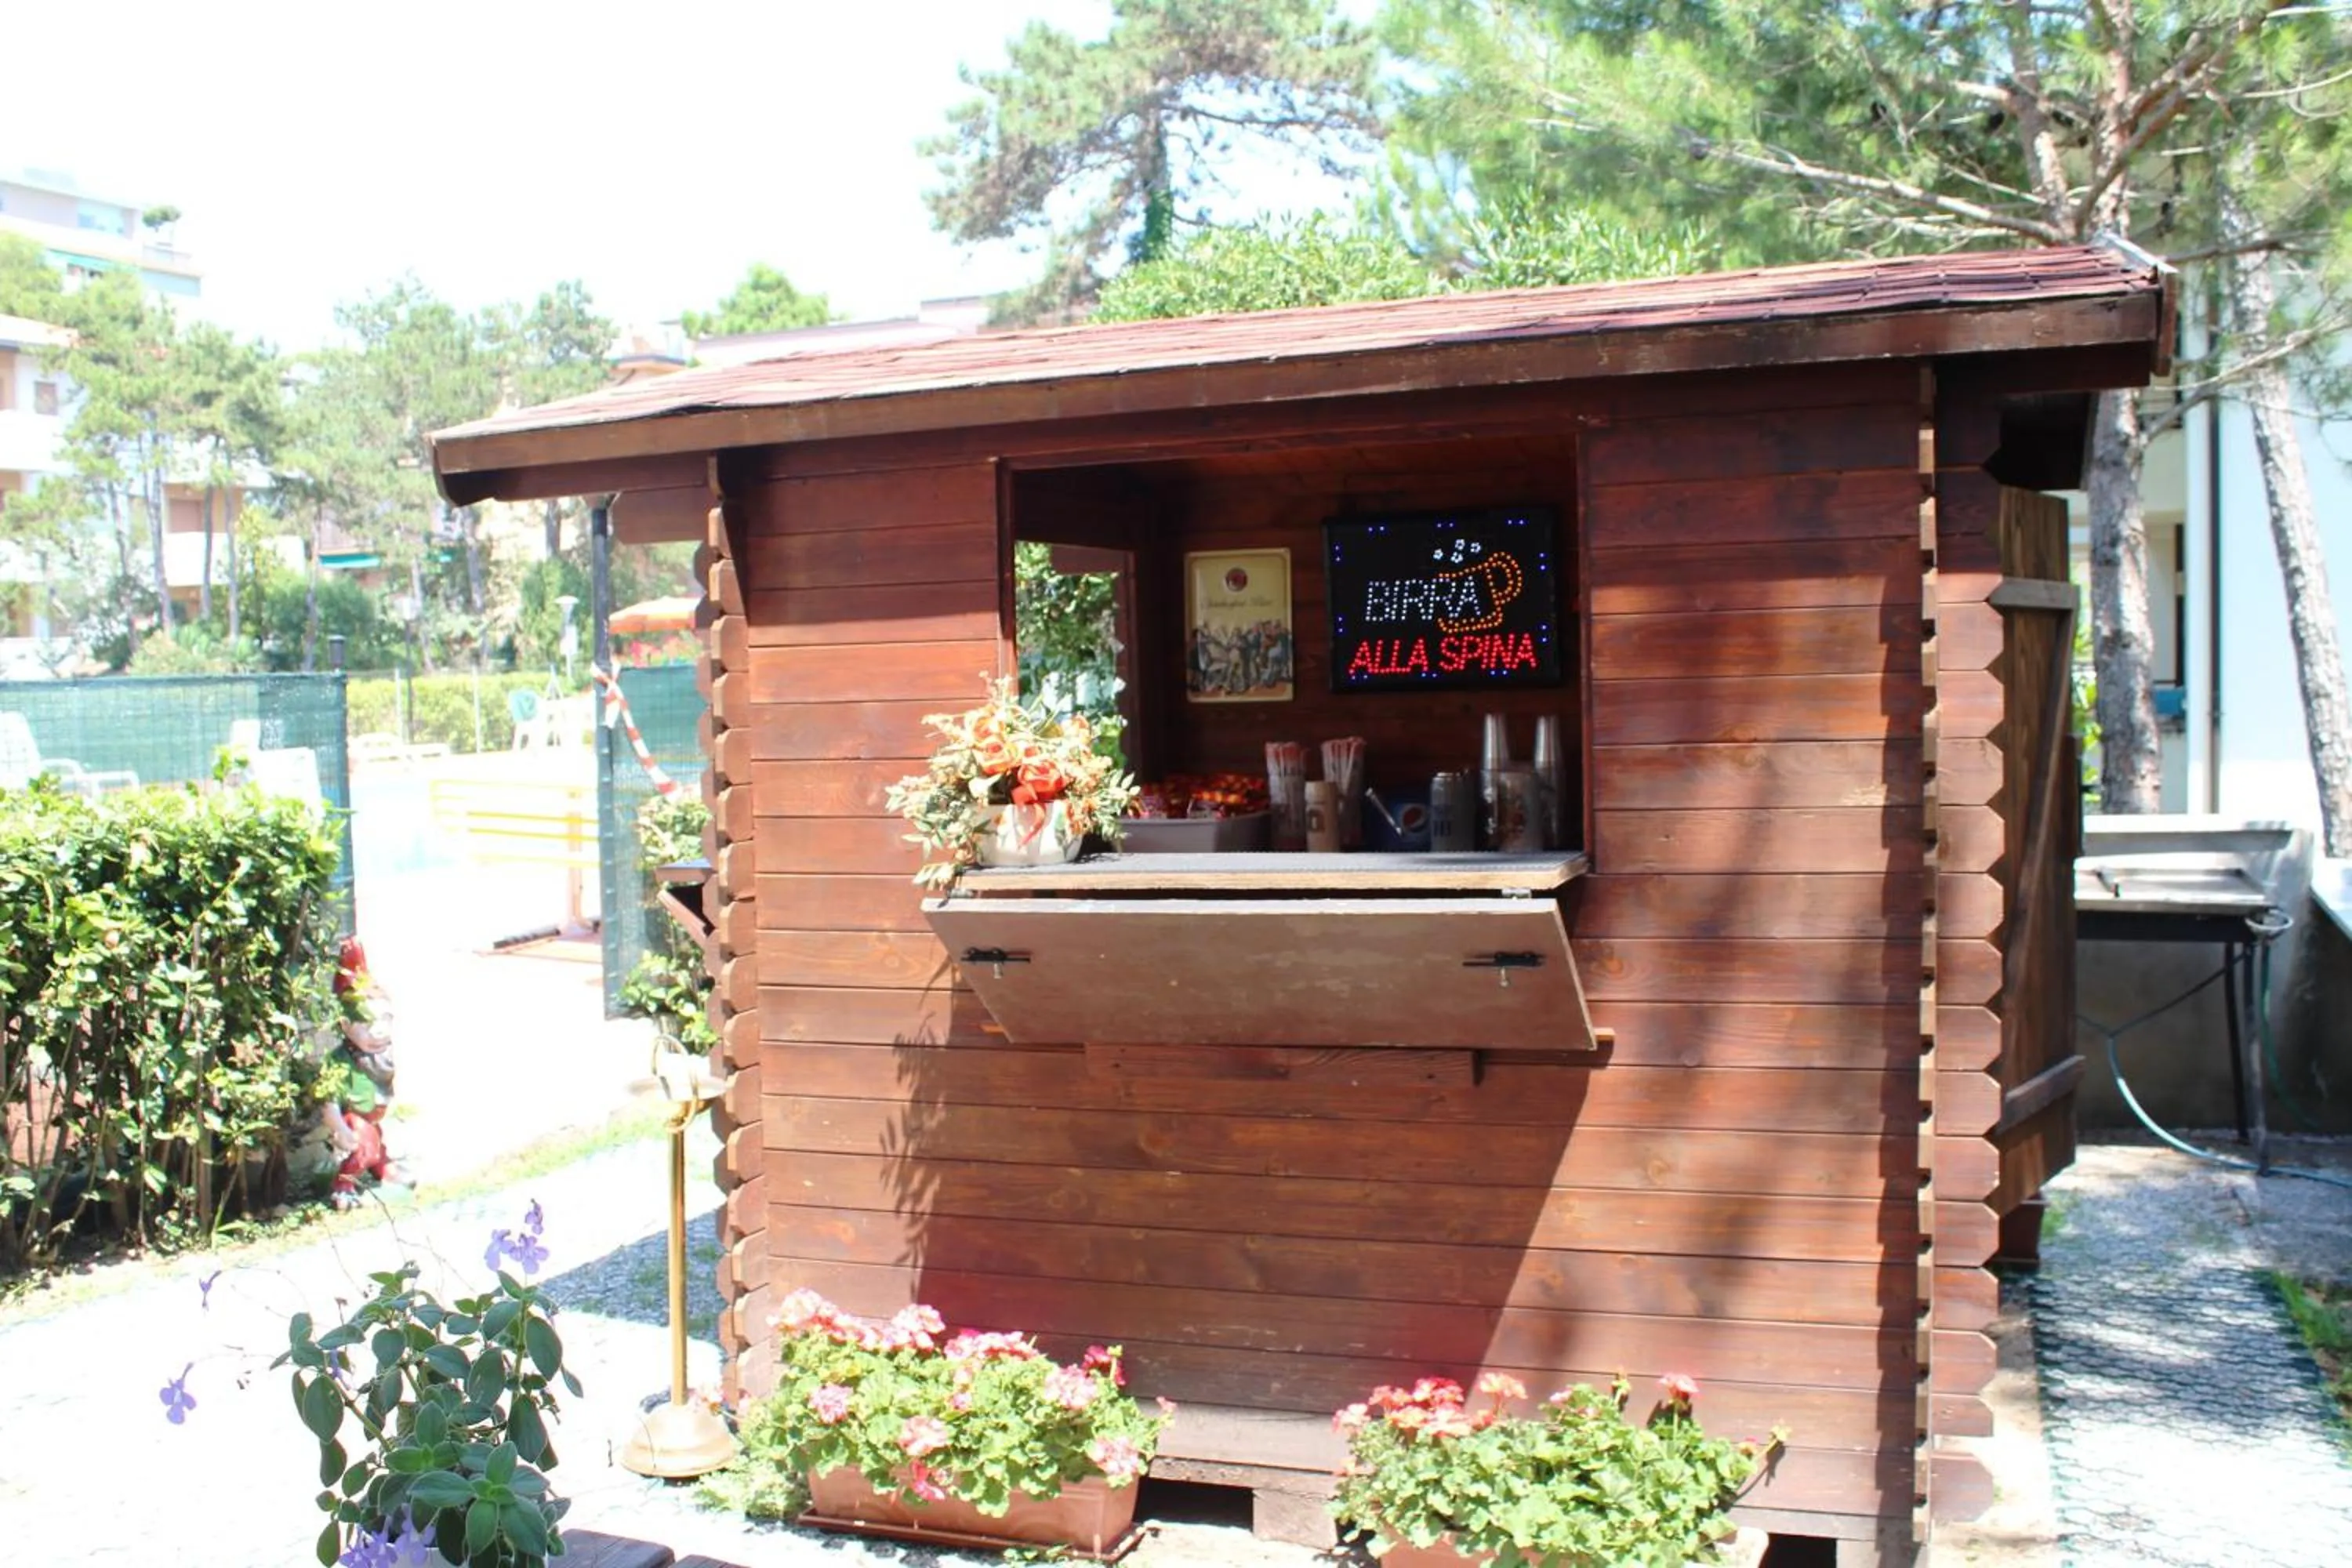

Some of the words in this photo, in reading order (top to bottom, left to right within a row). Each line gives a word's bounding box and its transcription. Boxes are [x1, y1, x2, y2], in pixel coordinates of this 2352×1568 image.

[1365, 575, 1481, 620] BIRRA
[1348, 638, 1429, 674] ALLA
[1438, 633, 1538, 671] SPINA
